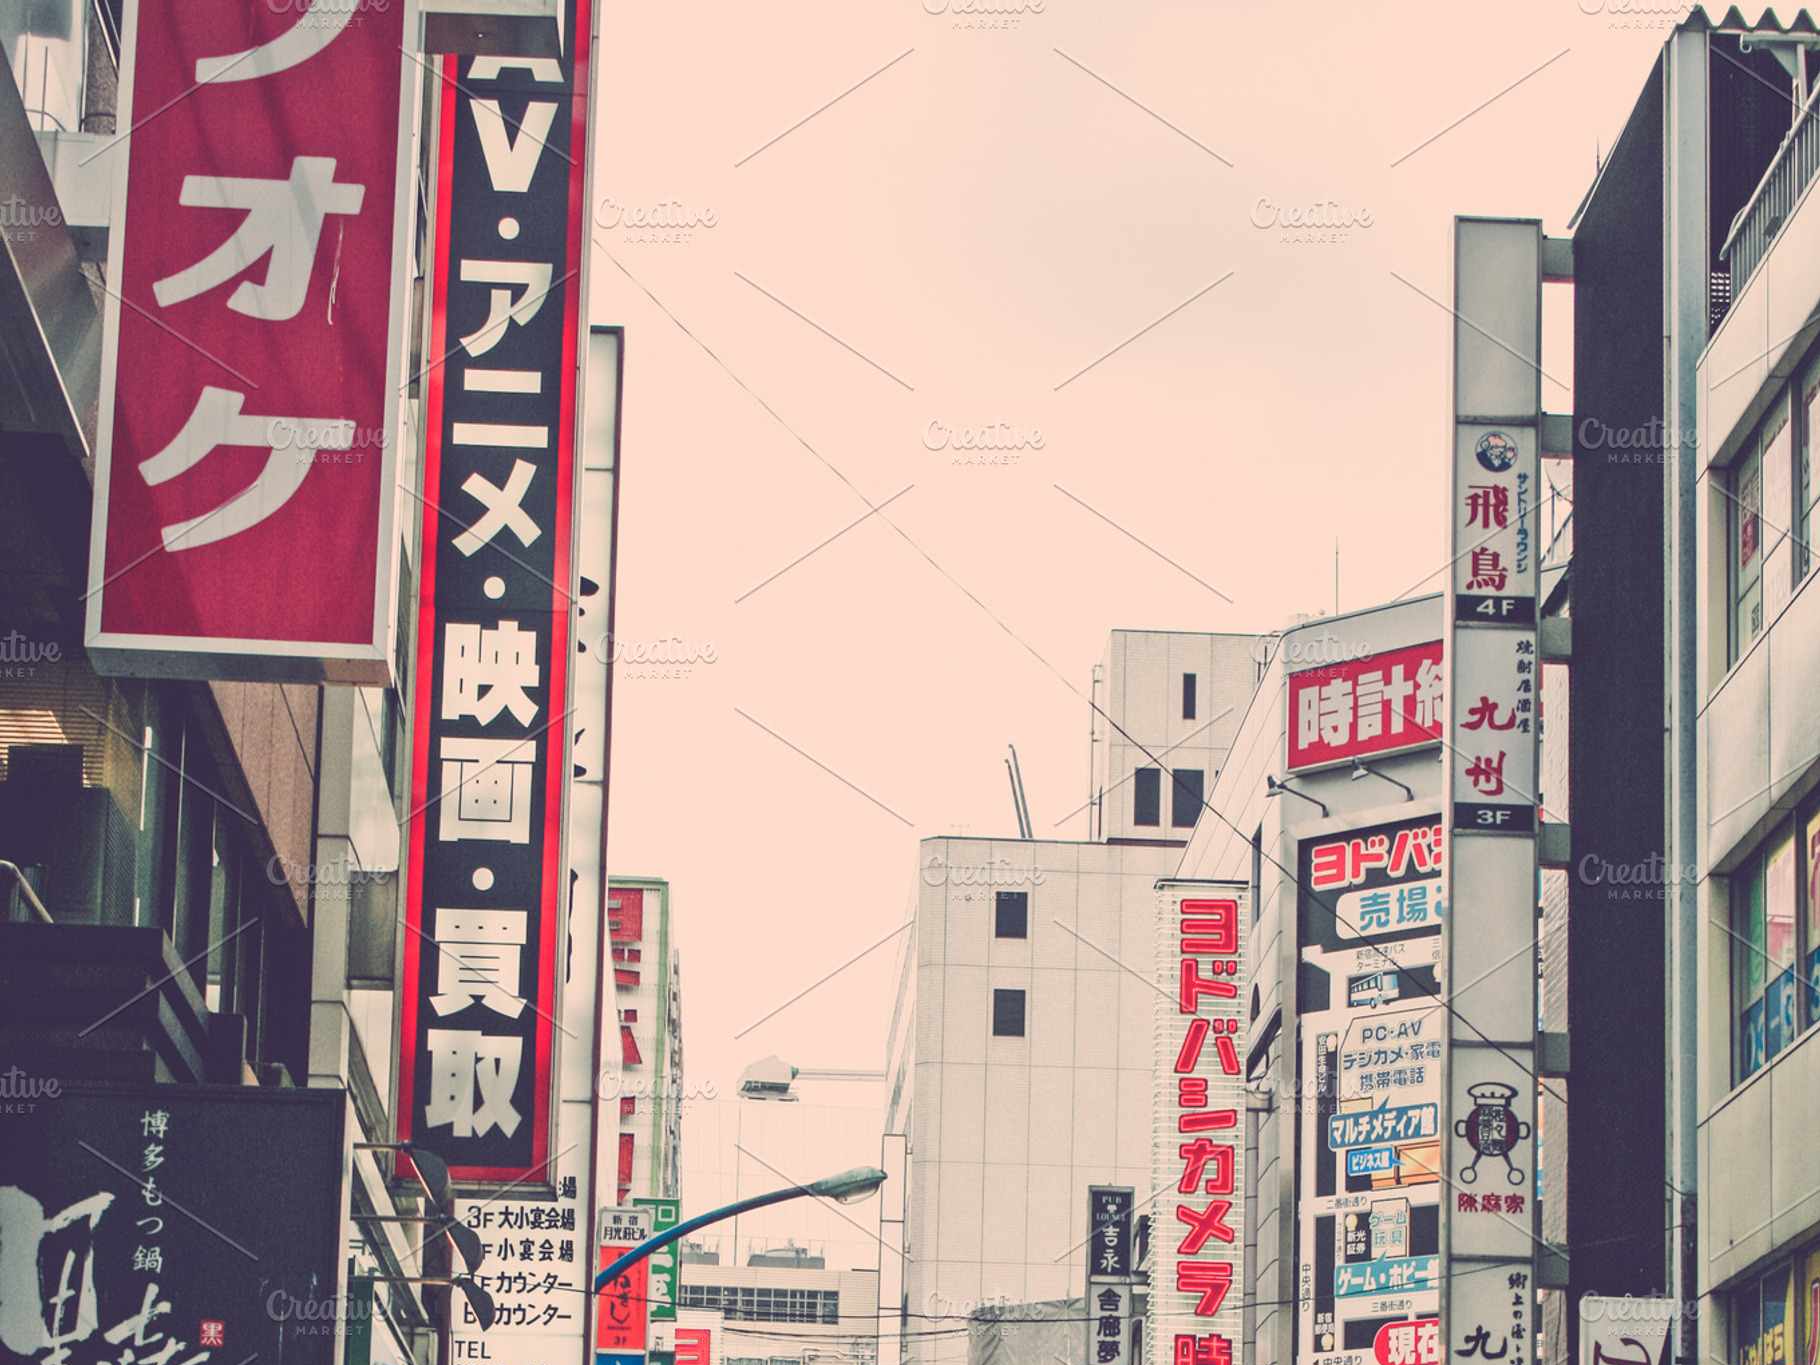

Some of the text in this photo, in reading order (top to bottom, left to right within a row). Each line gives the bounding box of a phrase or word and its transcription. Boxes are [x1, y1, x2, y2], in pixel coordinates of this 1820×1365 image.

[1465, 484, 1509, 592] 飛鳥
[425, 56, 565, 1138] V・アニメ・映画・買取
[1476, 599, 1515, 616] 4F
[1460, 696, 1517, 796] 九州
[1476, 809, 1512, 825] 3F
[1359, 1066, 1425, 1092] 携帯電話
[1331, 1106, 1437, 1145] マルチメディア館
[132, 1108, 170, 1275] 博多もつ鍋
[1457, 1192, 1525, 1215] 陳麻家
[467, 1205, 576, 1231] 3F 大小宴会場
[1368, 1208, 1408, 1228] ゲーム
[496, 1237, 575, 1263] 小宴会場
[1101, 1224, 1121, 1273] 吉永
[1373, 1229, 1403, 1246] 玩具
[495, 1271, 574, 1295] カウンター
[494, 1302, 573, 1326] カウンター
[454, 1340, 493, 1360] TEL
